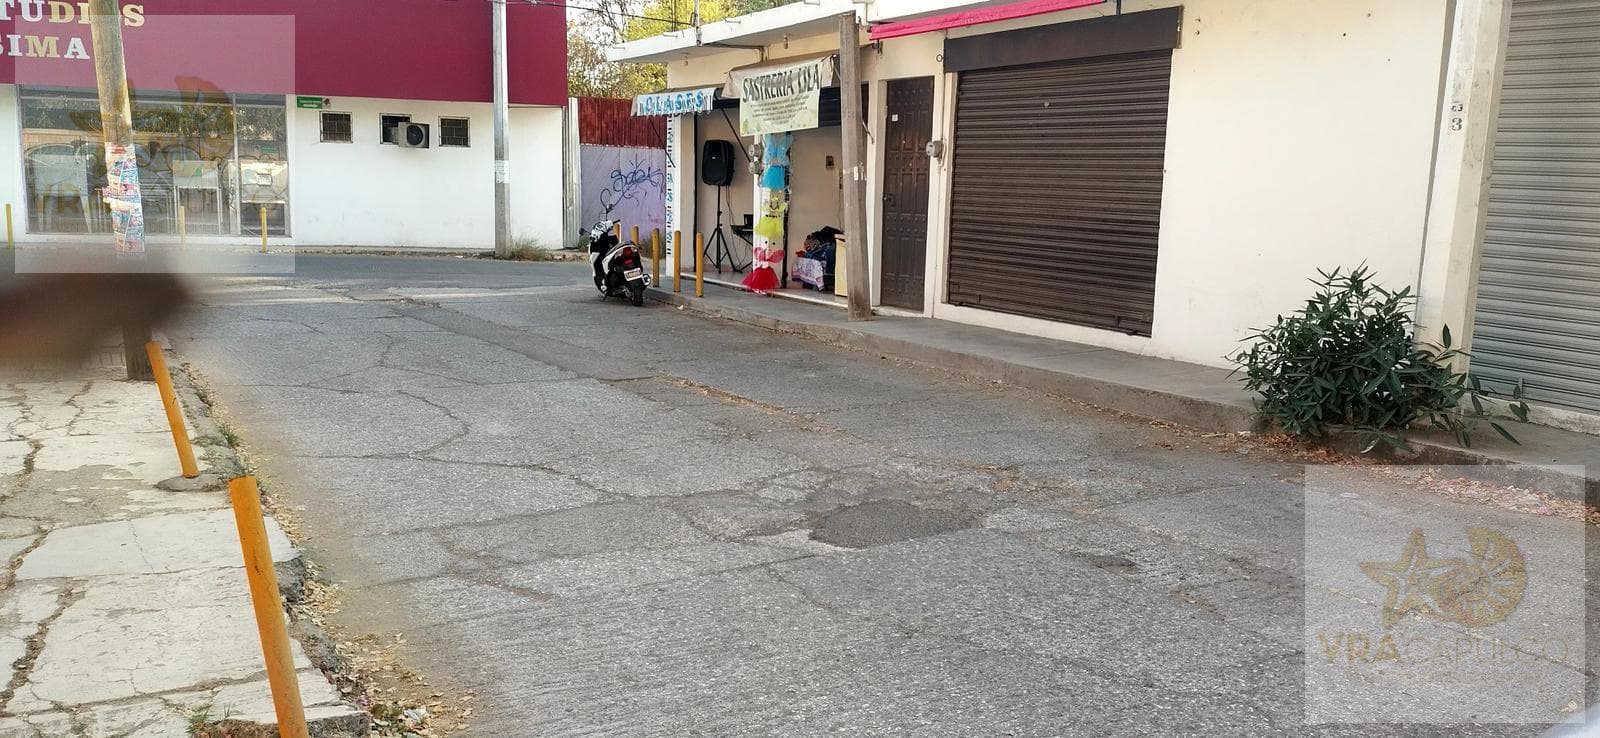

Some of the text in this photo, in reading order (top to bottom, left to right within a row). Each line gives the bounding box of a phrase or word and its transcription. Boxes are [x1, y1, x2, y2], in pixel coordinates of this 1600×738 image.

[0, 0, 145, 27] TUDIS
[0, 34, 91, 60] IMA
[742, 63, 820, 103] SASTRERIA LILA
[644, 91, 704, 112] CLASES
